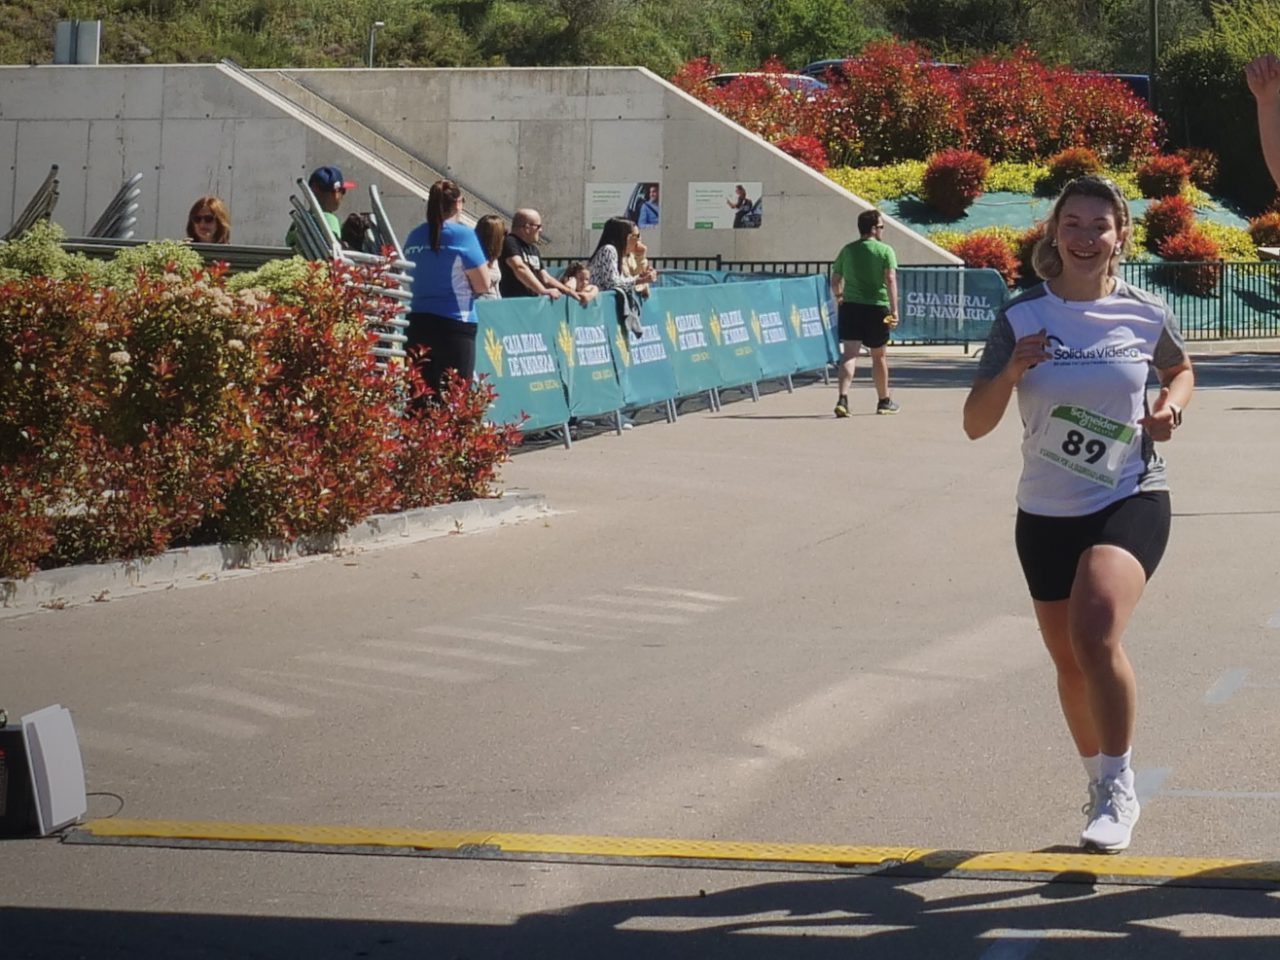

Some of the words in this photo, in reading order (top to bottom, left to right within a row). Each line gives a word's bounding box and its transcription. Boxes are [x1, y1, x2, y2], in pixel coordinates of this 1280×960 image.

[907, 292, 940, 305] CAJA
[943, 294, 990, 308] RURAL
[906, 305, 926, 317] DE
[929, 307, 996, 321] NAVARRA
[1054, 348, 1096, 360] Solidus
[1096, 347, 1139, 358] Videca
[1070, 407, 1119, 431] Schneider
[1061, 429, 1107, 464] 89
